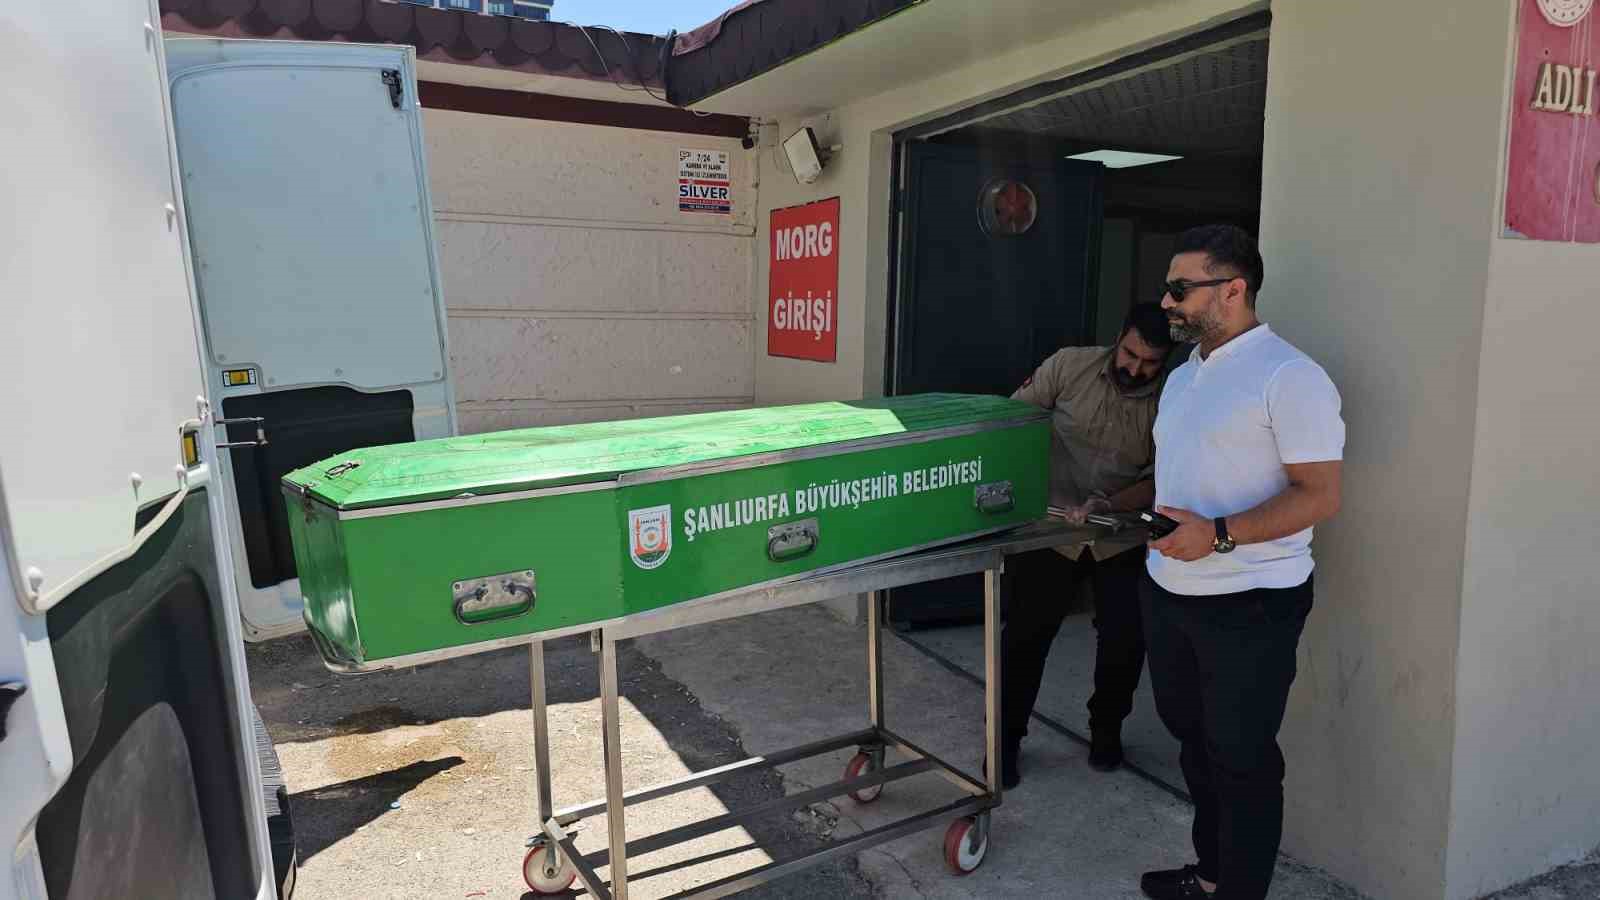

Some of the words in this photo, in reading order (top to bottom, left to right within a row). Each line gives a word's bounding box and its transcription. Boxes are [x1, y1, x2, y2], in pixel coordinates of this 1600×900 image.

[776, 221, 832, 261] MORG
[773, 289, 832, 341] GİRİŞİ
[684, 492, 790, 542] ŞANLIURFA
[795, 471, 898, 514] BÜYÜKŞEHİR
[903, 455, 982, 495] BELEDİYESİ
